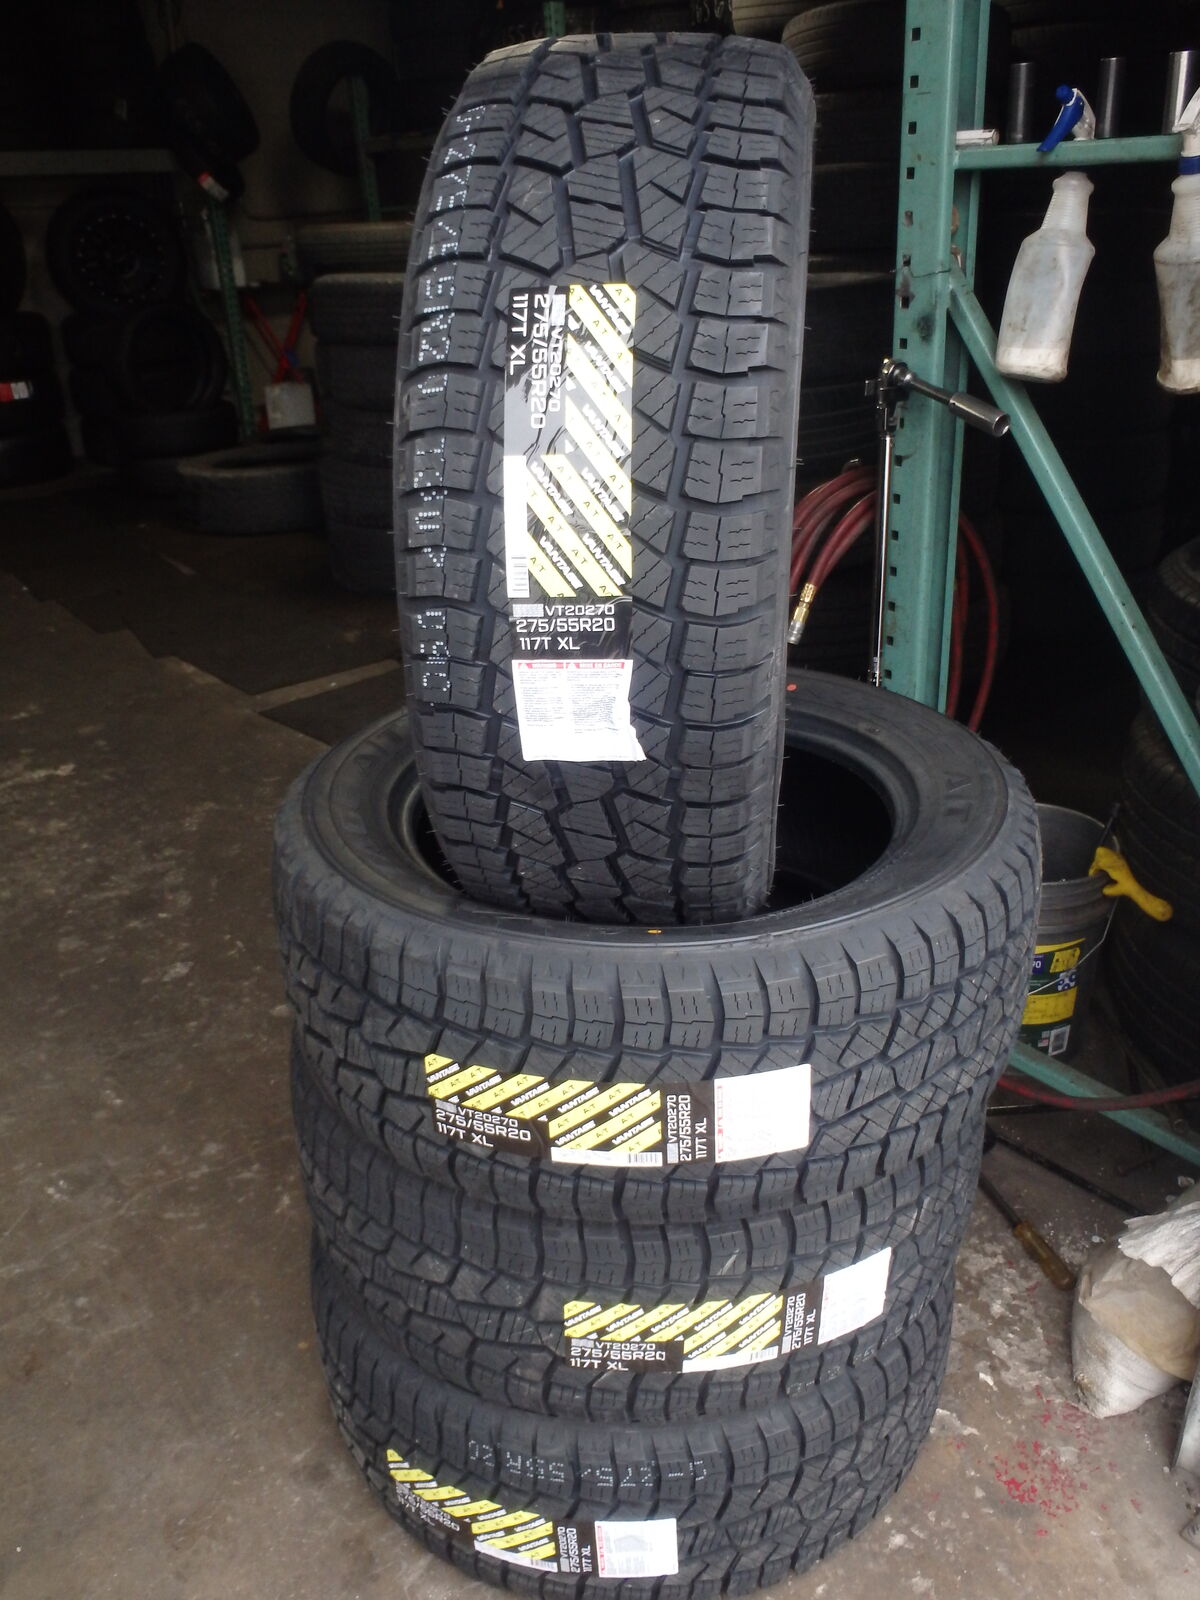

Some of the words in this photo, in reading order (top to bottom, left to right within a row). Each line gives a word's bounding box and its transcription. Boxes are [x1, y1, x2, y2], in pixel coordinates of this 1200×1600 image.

[511, 293, 529, 337] 117T
[510, 344, 527, 376] XL
[530, 294, 550, 429] 275/55R20
[549, 327, 565, 412] VT20270
[545, 604, 615, 617] VT20270
[516, 617, 616, 633] 275/55R20
[520, 637, 552, 651] 117T
[557, 637, 580, 651] XL
[435, 1109, 531, 1141] 275/55R20
[458, 1107, 518, 1128] VT20270
[667, 1094, 677, 1143] VT20270
[678, 1094, 692, 1162] 275/55R20
[696, 1117, 707, 1134] XL
[437, 1122, 466, 1139] 117T
[471, 1132, 494, 1147] XL
[695, 1137, 707, 1160] 117T
[806, 1308, 816, 1325] XL
[570, 1347, 666, 1361] 275/55R20
[595, 1341, 656, 1351] VT20270
[570, 1358, 602, 1369] 117T
[607, 1361, 629, 1371] XL
